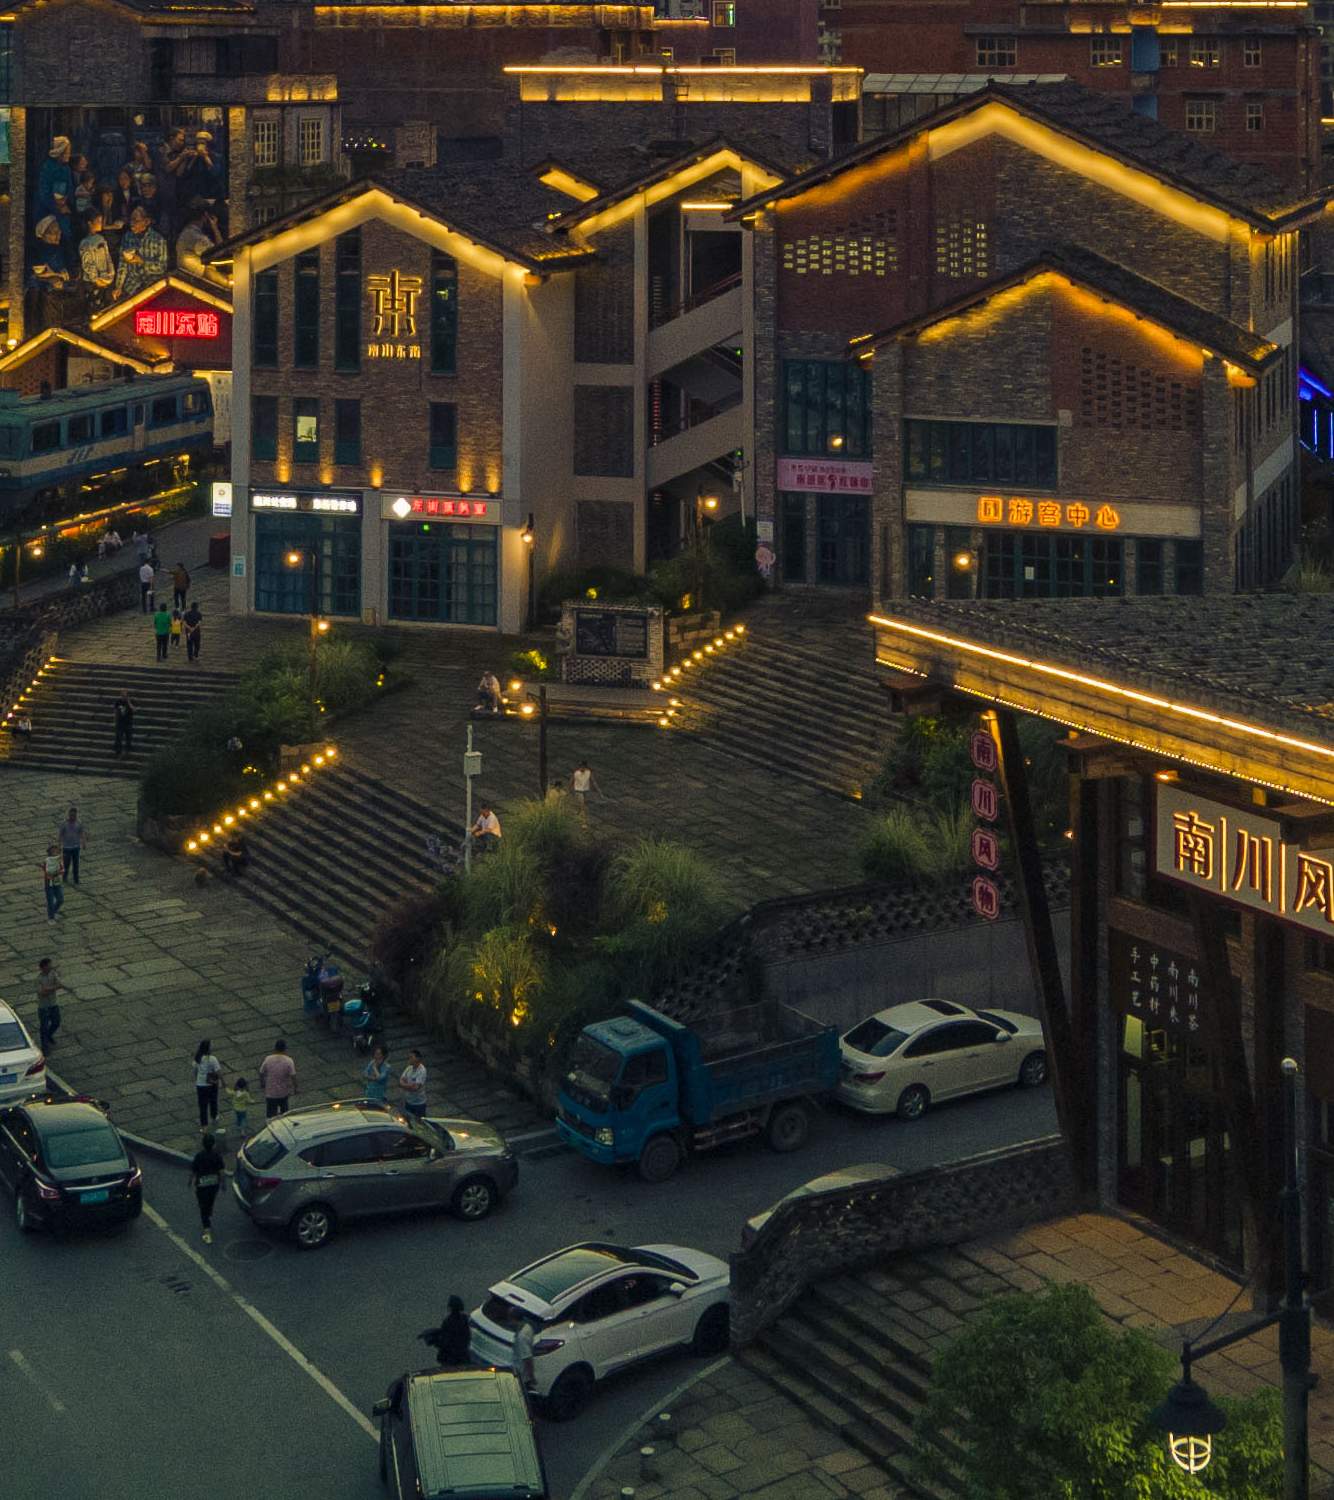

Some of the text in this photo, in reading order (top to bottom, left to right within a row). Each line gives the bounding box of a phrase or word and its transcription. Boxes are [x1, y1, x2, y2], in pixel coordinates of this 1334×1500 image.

[137, 311, 219, 336] 南川东站
[1008, 500, 1119, 530] 游客中心
[975, 737, 996, 912] 南川风物
